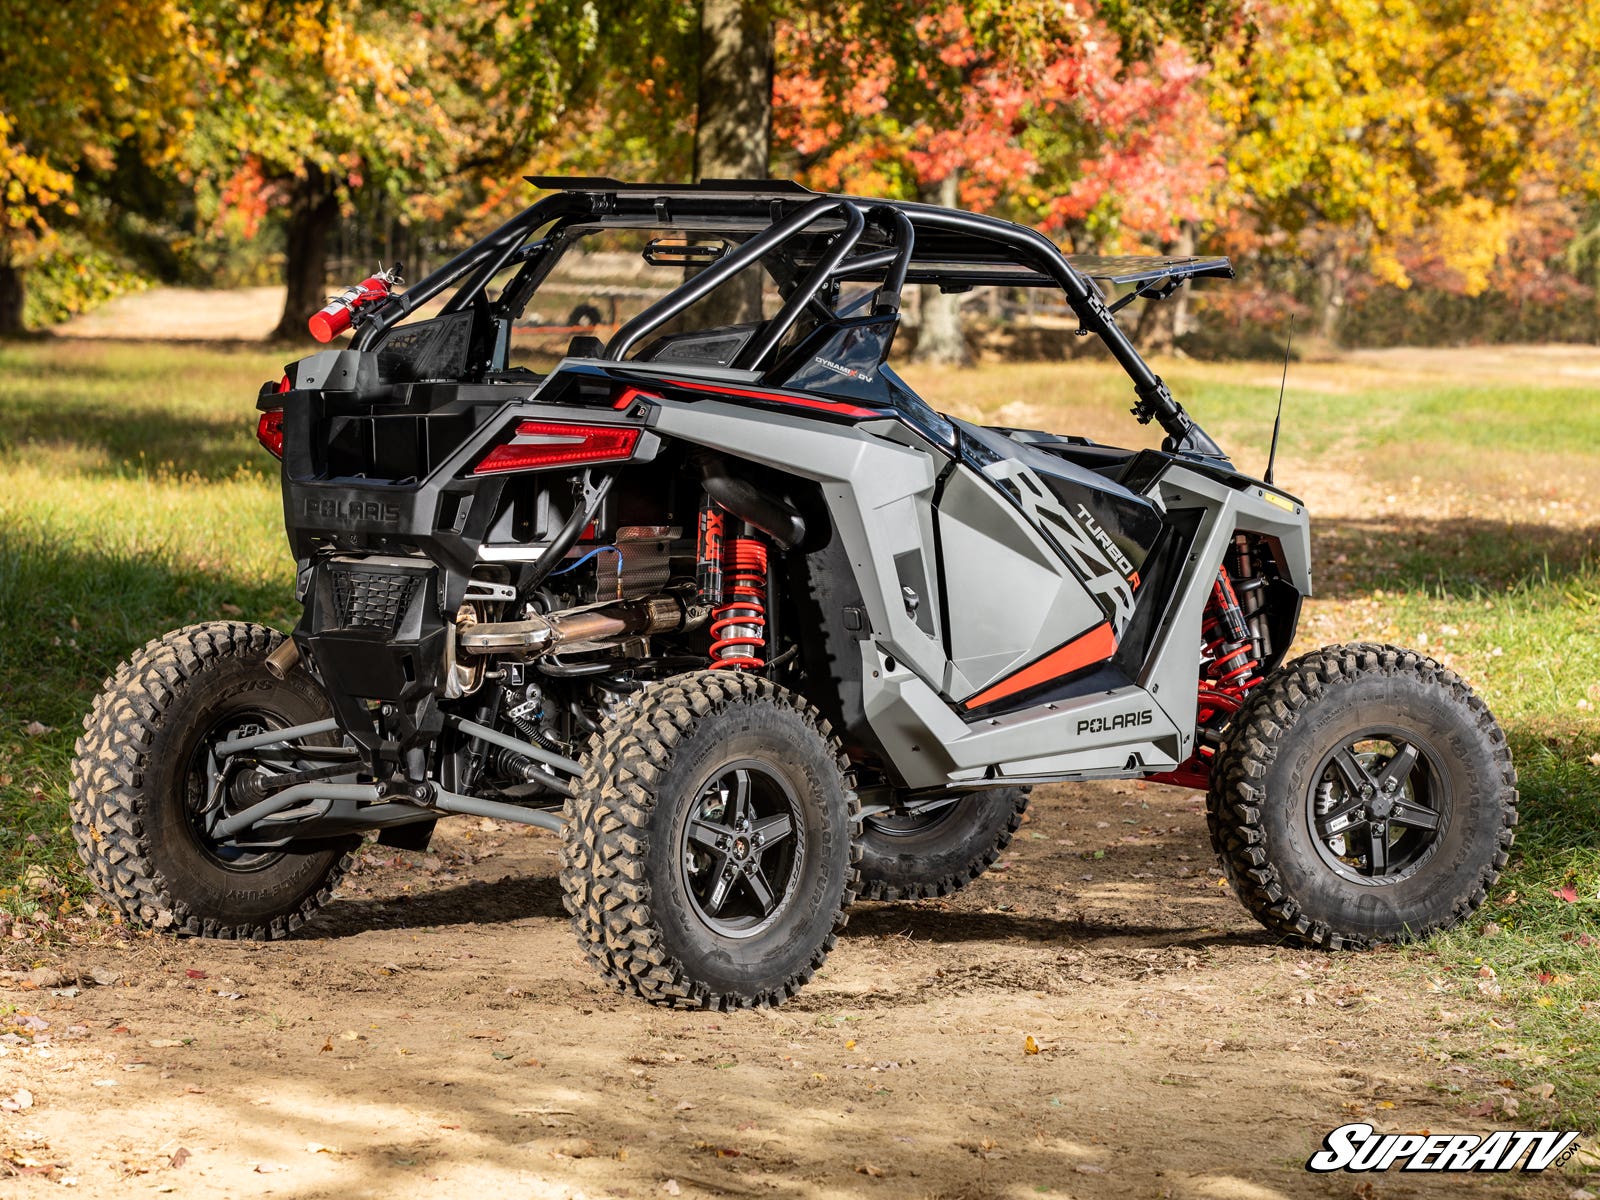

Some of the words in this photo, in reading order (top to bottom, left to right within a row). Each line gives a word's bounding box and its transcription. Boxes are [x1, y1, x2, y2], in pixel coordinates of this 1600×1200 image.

[815, 356, 858, 378] DYNAMIX
[857, 373, 873, 383] DV
[303, 498, 400, 525] POLARIS
[980, 457, 1137, 639] RZR
[1077, 709, 1153, 736] POLARIS
[803, 765, 832, 857] RAMPAGE
[809, 864, 830, 918] FURY
